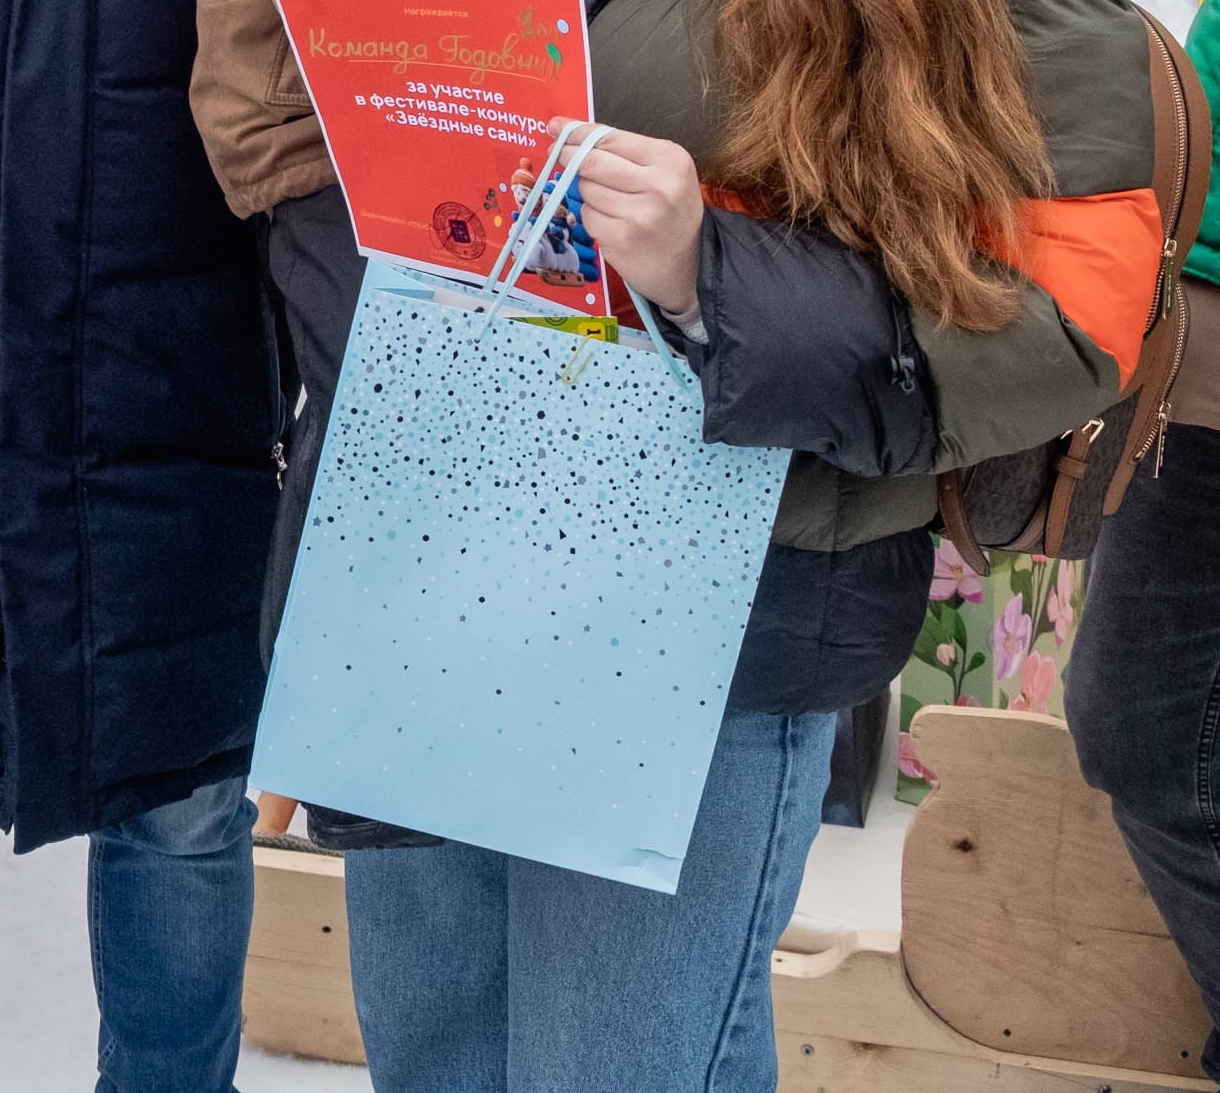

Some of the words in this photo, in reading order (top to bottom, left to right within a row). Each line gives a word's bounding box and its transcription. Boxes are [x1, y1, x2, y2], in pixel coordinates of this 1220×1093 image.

[309, 28, 429, 75] Команда
[355, 95, 367, 106] в
[406, 81, 428, 94] за
[430, 83, 505, 105] участие
[386, 110, 485, 137] «Звёздные
[487, 126, 538, 148] сани»
